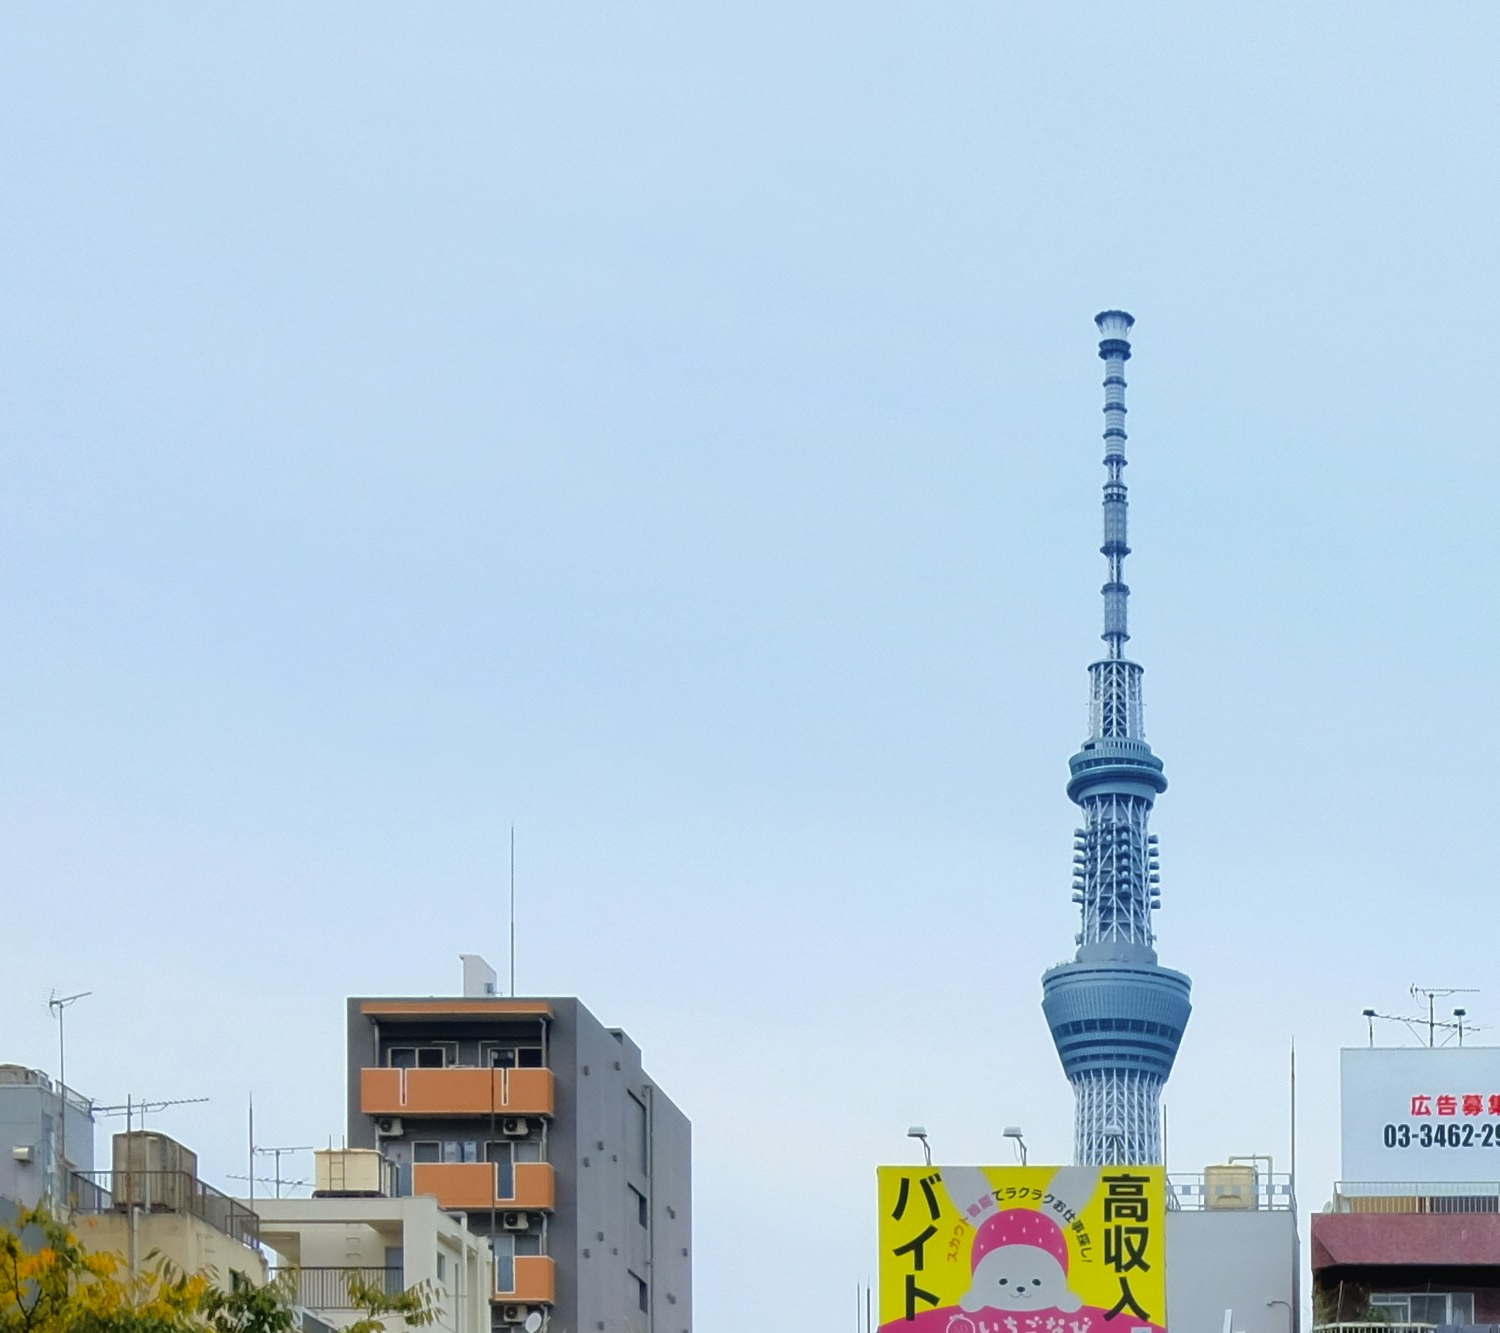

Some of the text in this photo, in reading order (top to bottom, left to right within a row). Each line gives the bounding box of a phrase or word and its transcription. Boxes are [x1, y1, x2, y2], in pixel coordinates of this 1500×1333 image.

[891, 1173, 942, 1321] バイト
[1101, 1173, 1151, 1322] 高収入
